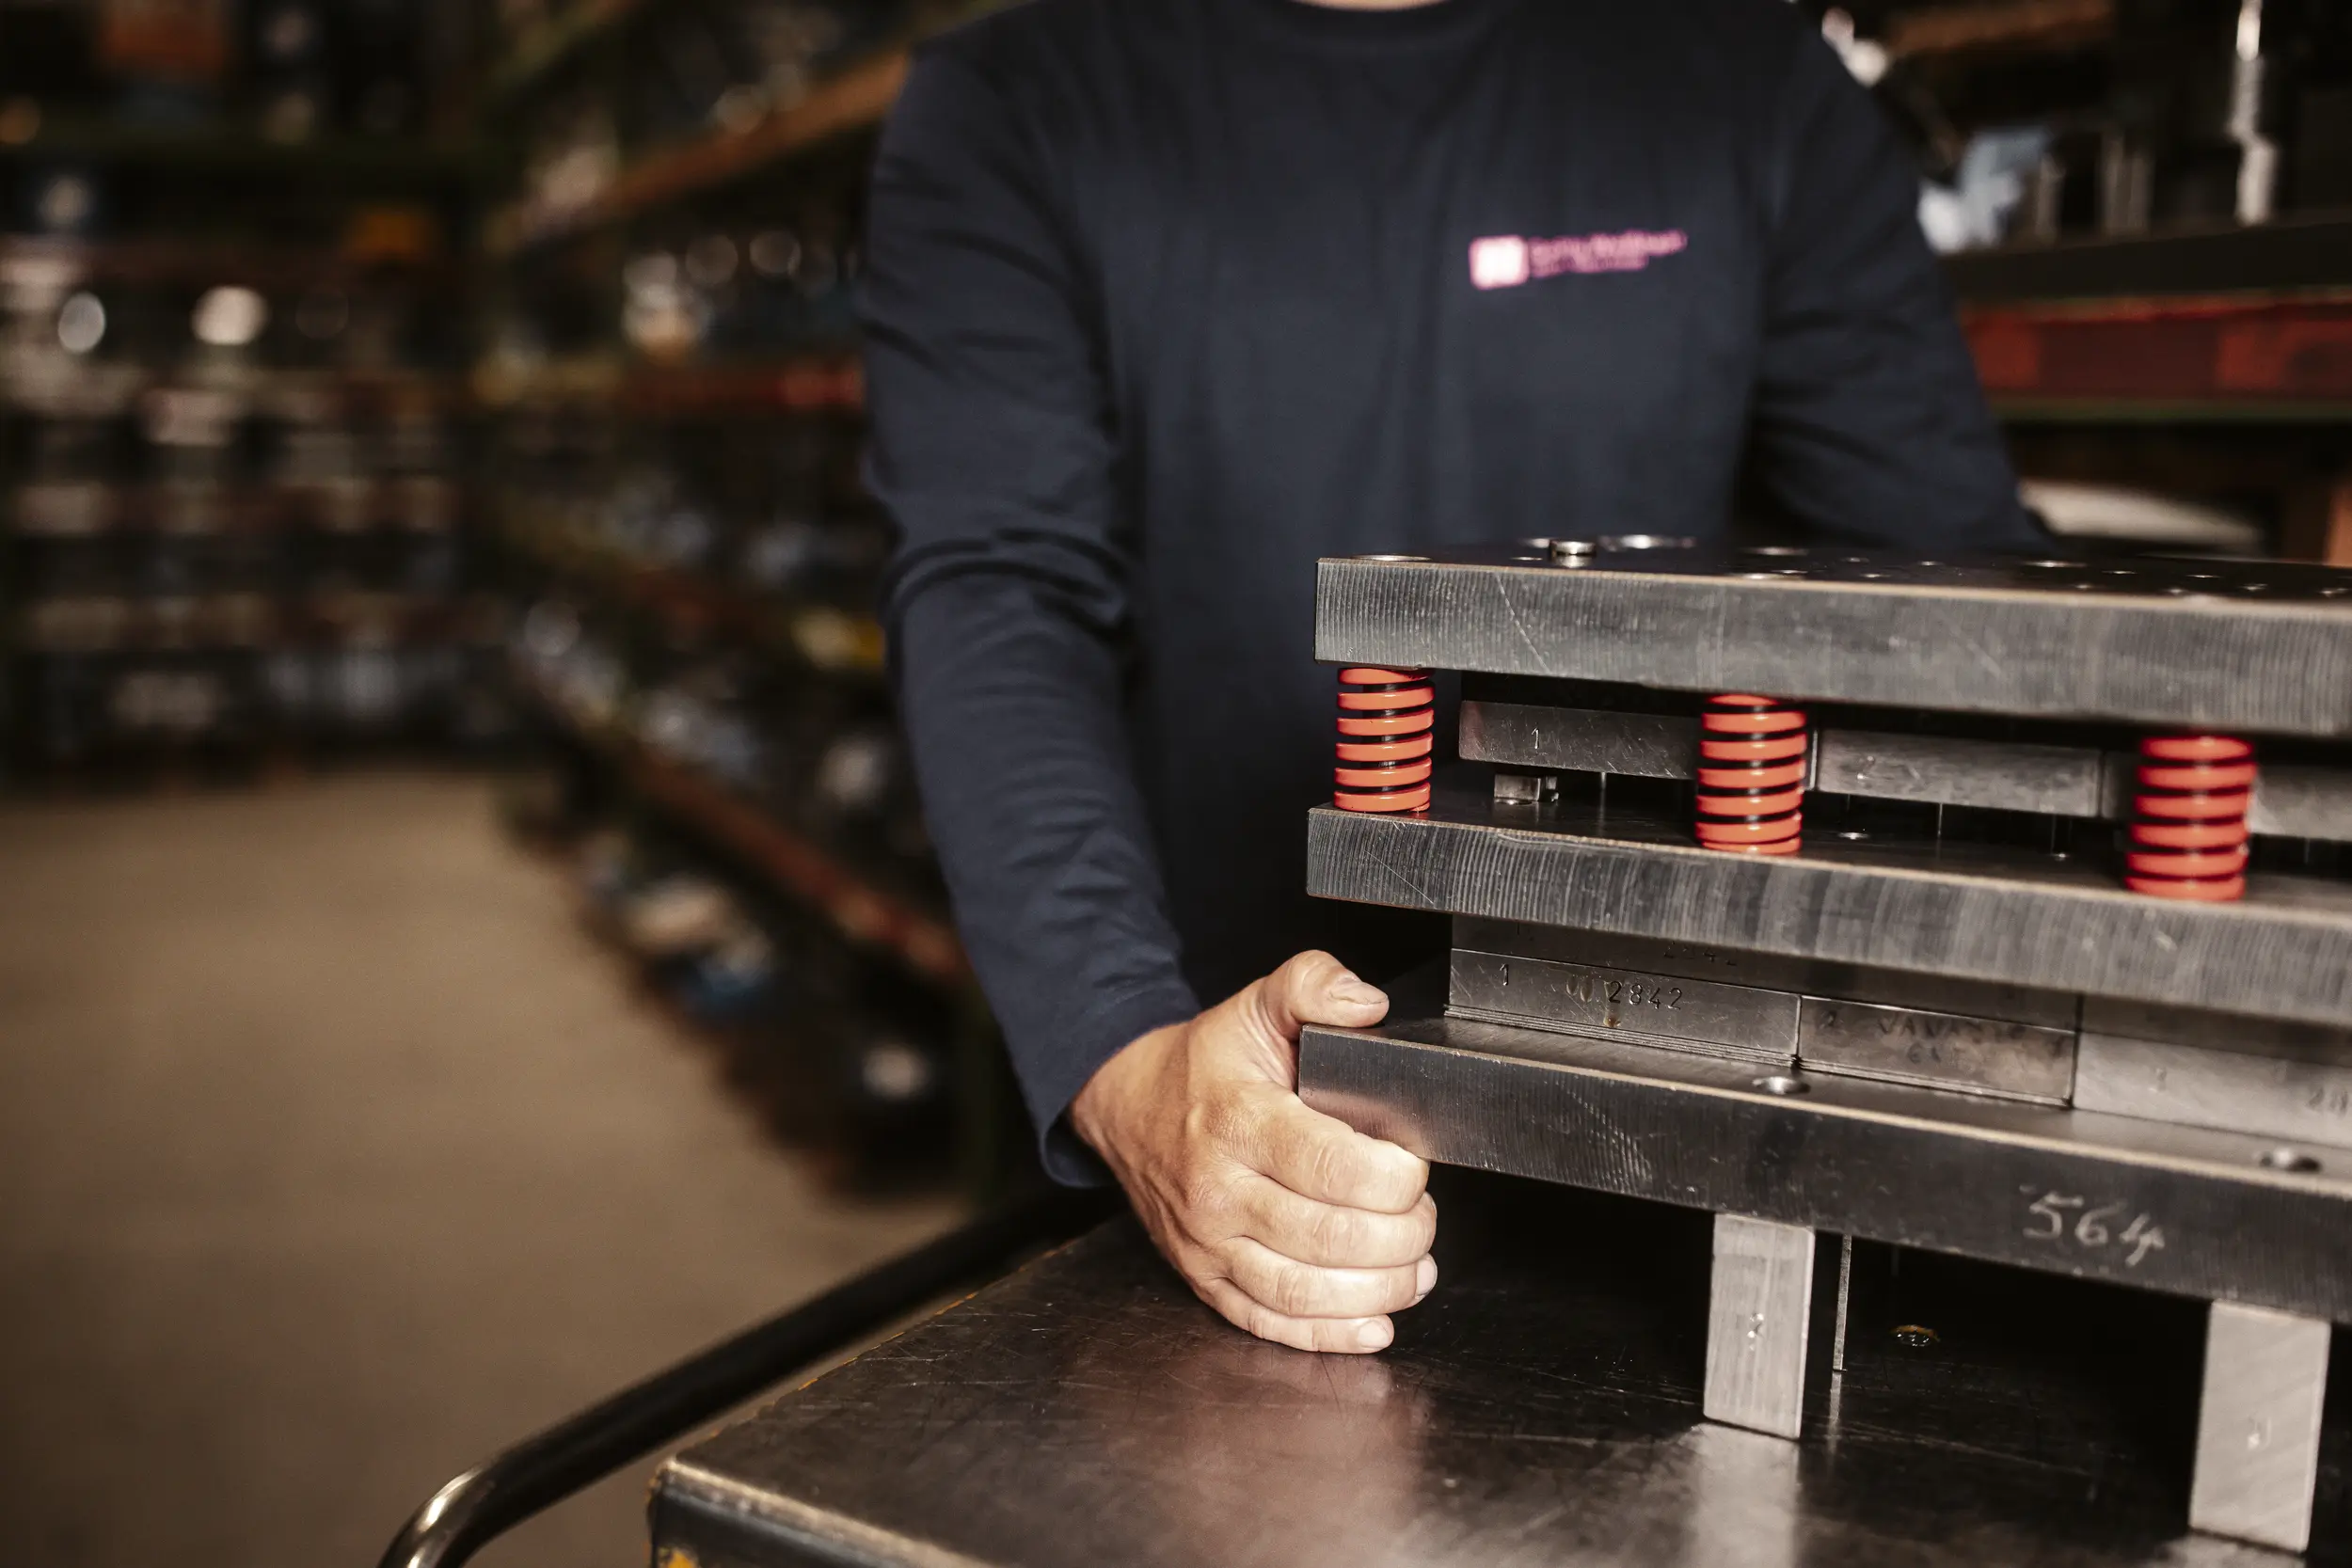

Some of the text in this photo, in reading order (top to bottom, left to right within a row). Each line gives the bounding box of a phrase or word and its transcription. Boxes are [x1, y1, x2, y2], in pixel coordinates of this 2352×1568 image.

[1531, 726, 1540, 750] 1
[1499, 962, 1684, 1011] 1 2842
[2022, 1190, 2166, 1267] 564
